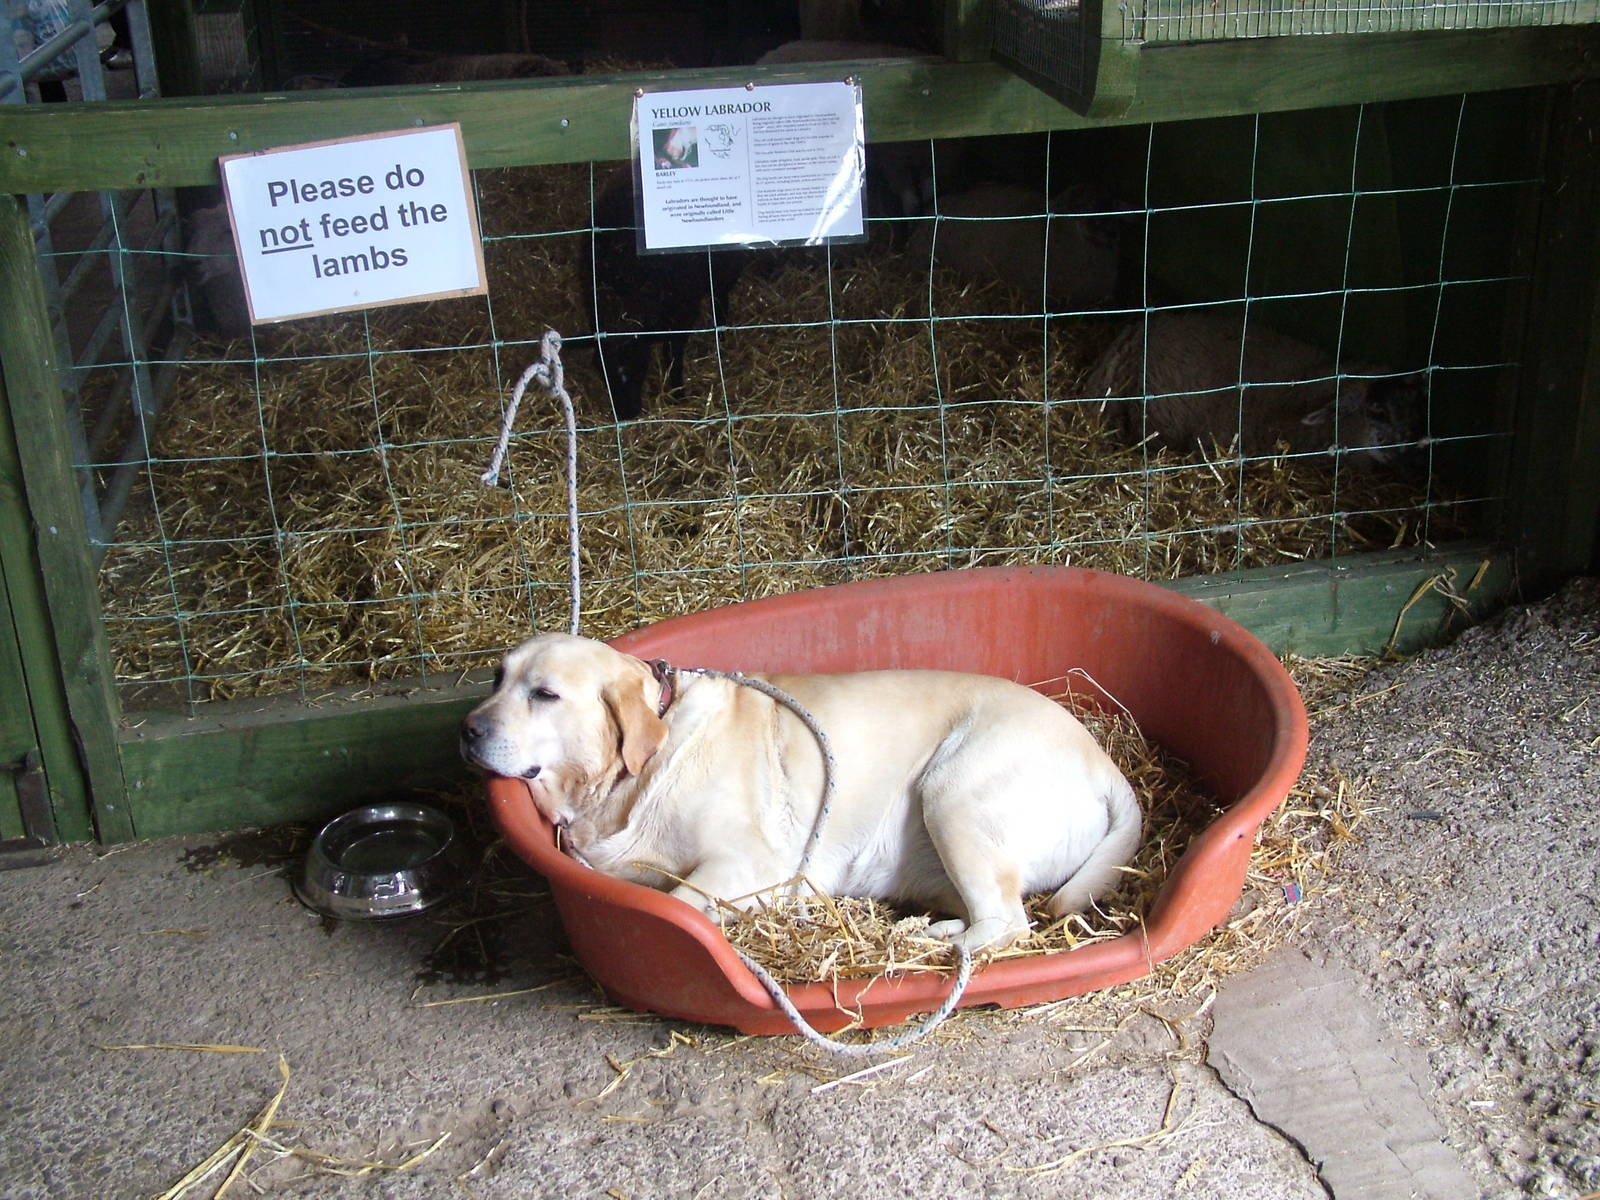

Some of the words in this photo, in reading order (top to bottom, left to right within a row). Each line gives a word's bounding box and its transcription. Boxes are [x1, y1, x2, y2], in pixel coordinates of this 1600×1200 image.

[652, 106, 701, 119] YELLOW
[705, 102, 771, 116] LABRADOR
[267, 175, 374, 207] Please
[385, 164, 425, 190] do
[260, 217, 314, 250] not
[320, 205, 389, 239] feed
[398, 201, 448, 227] the
[312, 246, 409, 278] lambs
